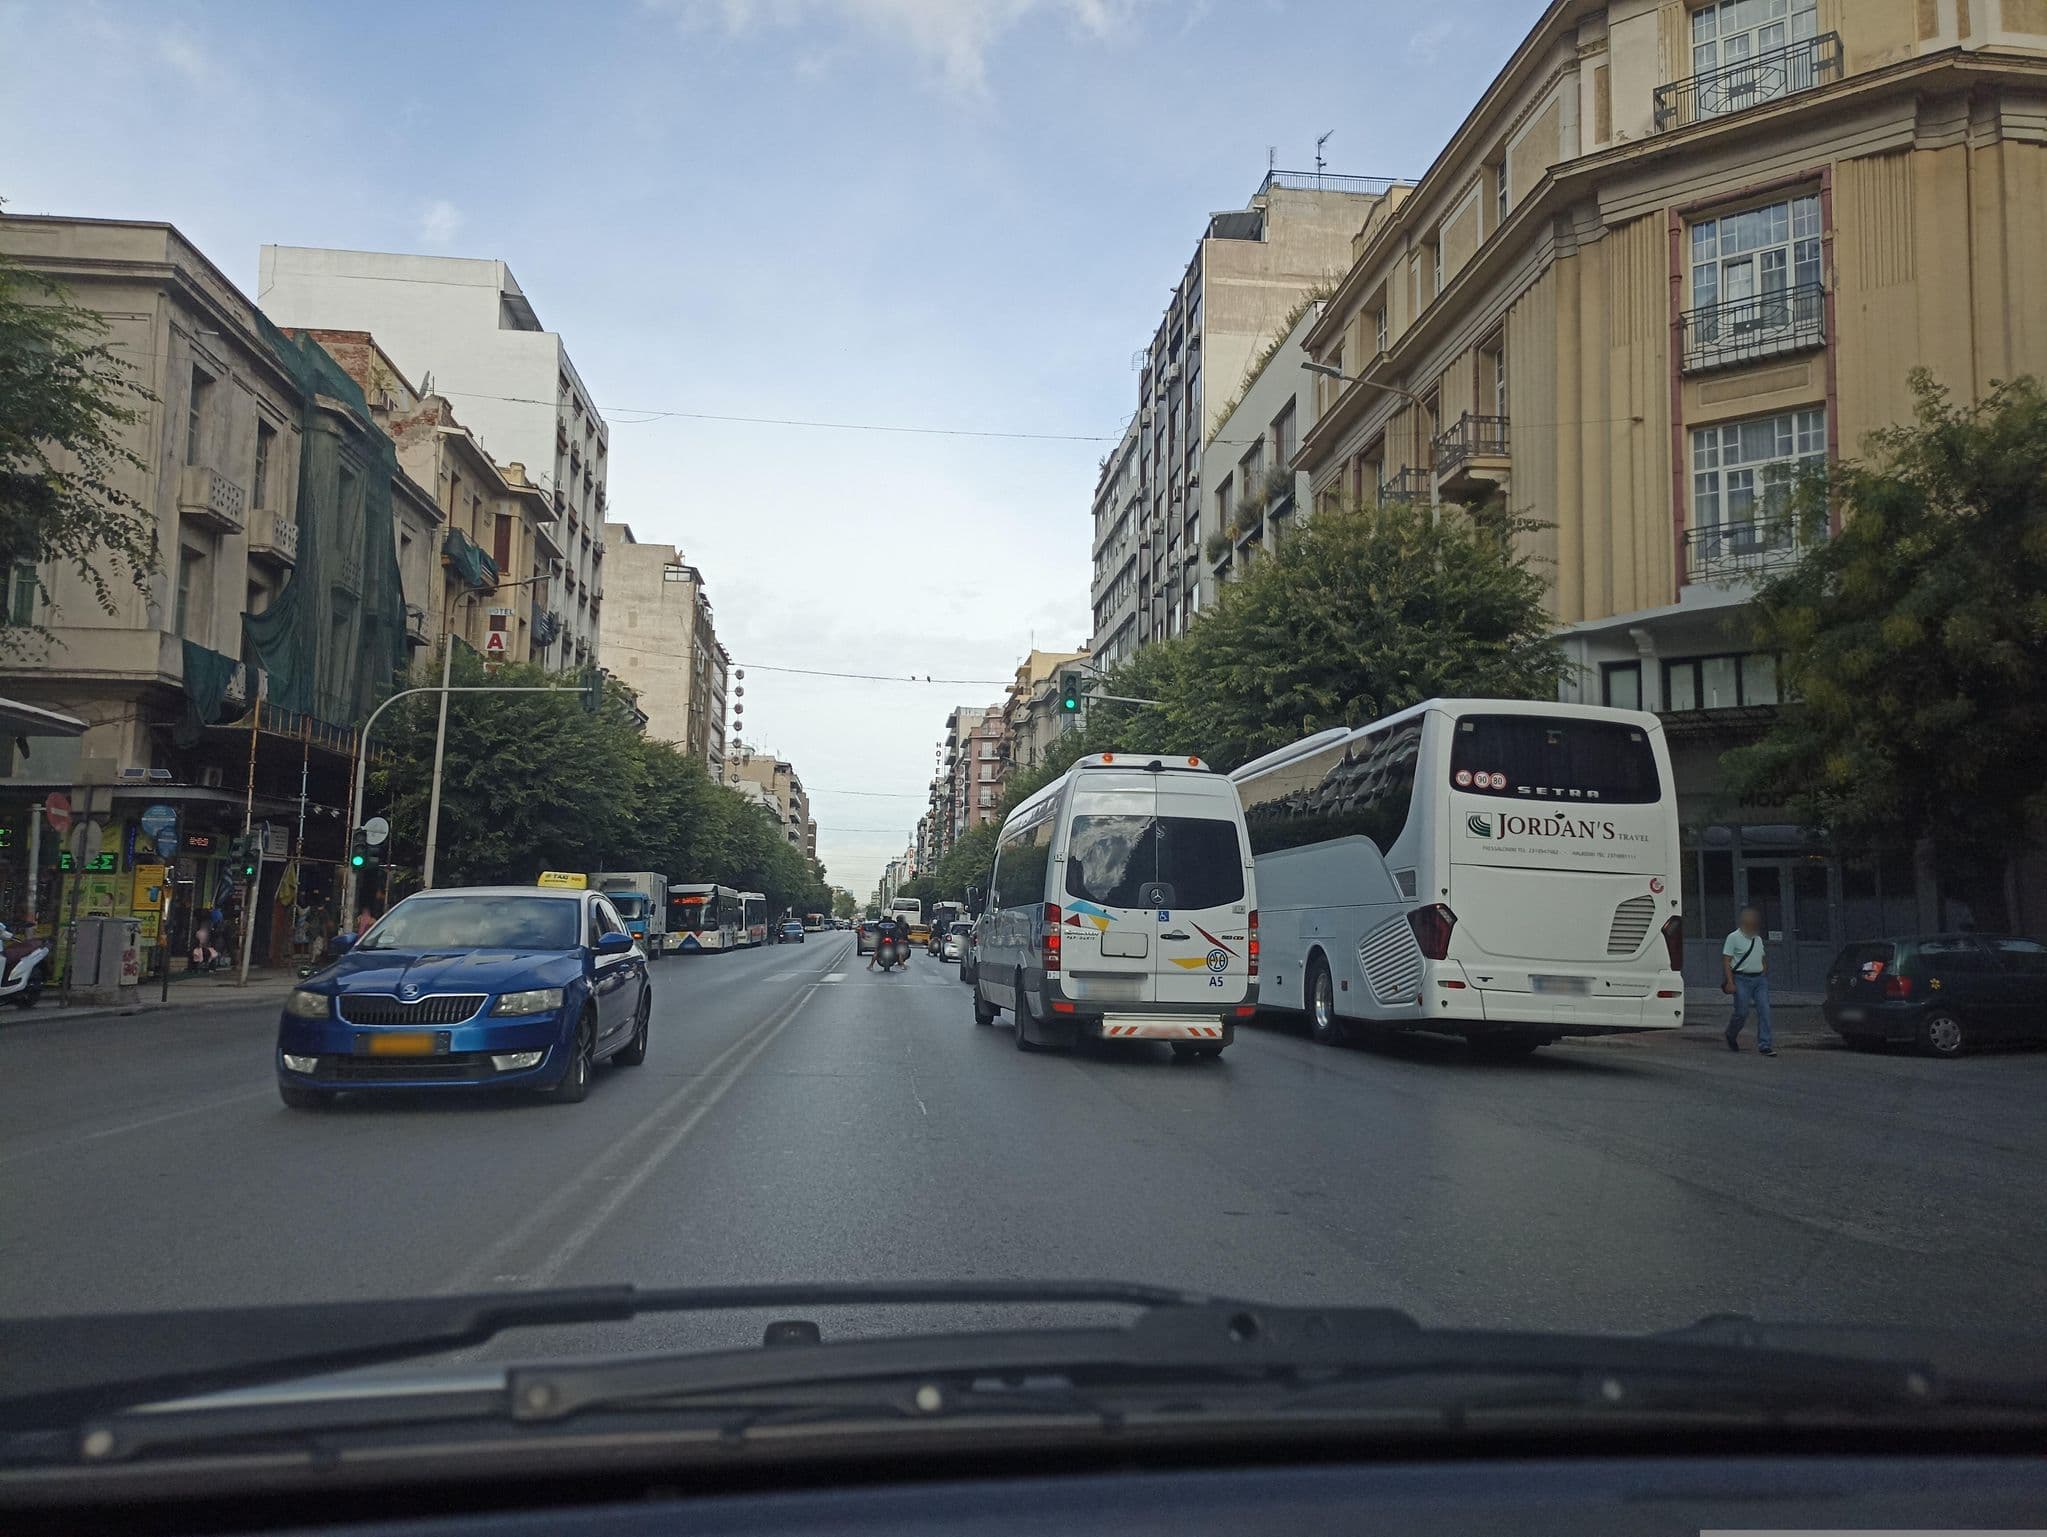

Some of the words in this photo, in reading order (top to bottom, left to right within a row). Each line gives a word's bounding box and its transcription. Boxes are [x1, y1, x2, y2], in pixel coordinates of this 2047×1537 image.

[1477, 775, 1487, 784] 90
[1493, 776, 1503, 785] 80
[1517, 786, 1600, 799] SETRA
[1496, 812, 1615, 840] JORDAN'S
[1618, 833, 1649, 842] TRAVEL
[1209, 975, 1224, 987] A5
